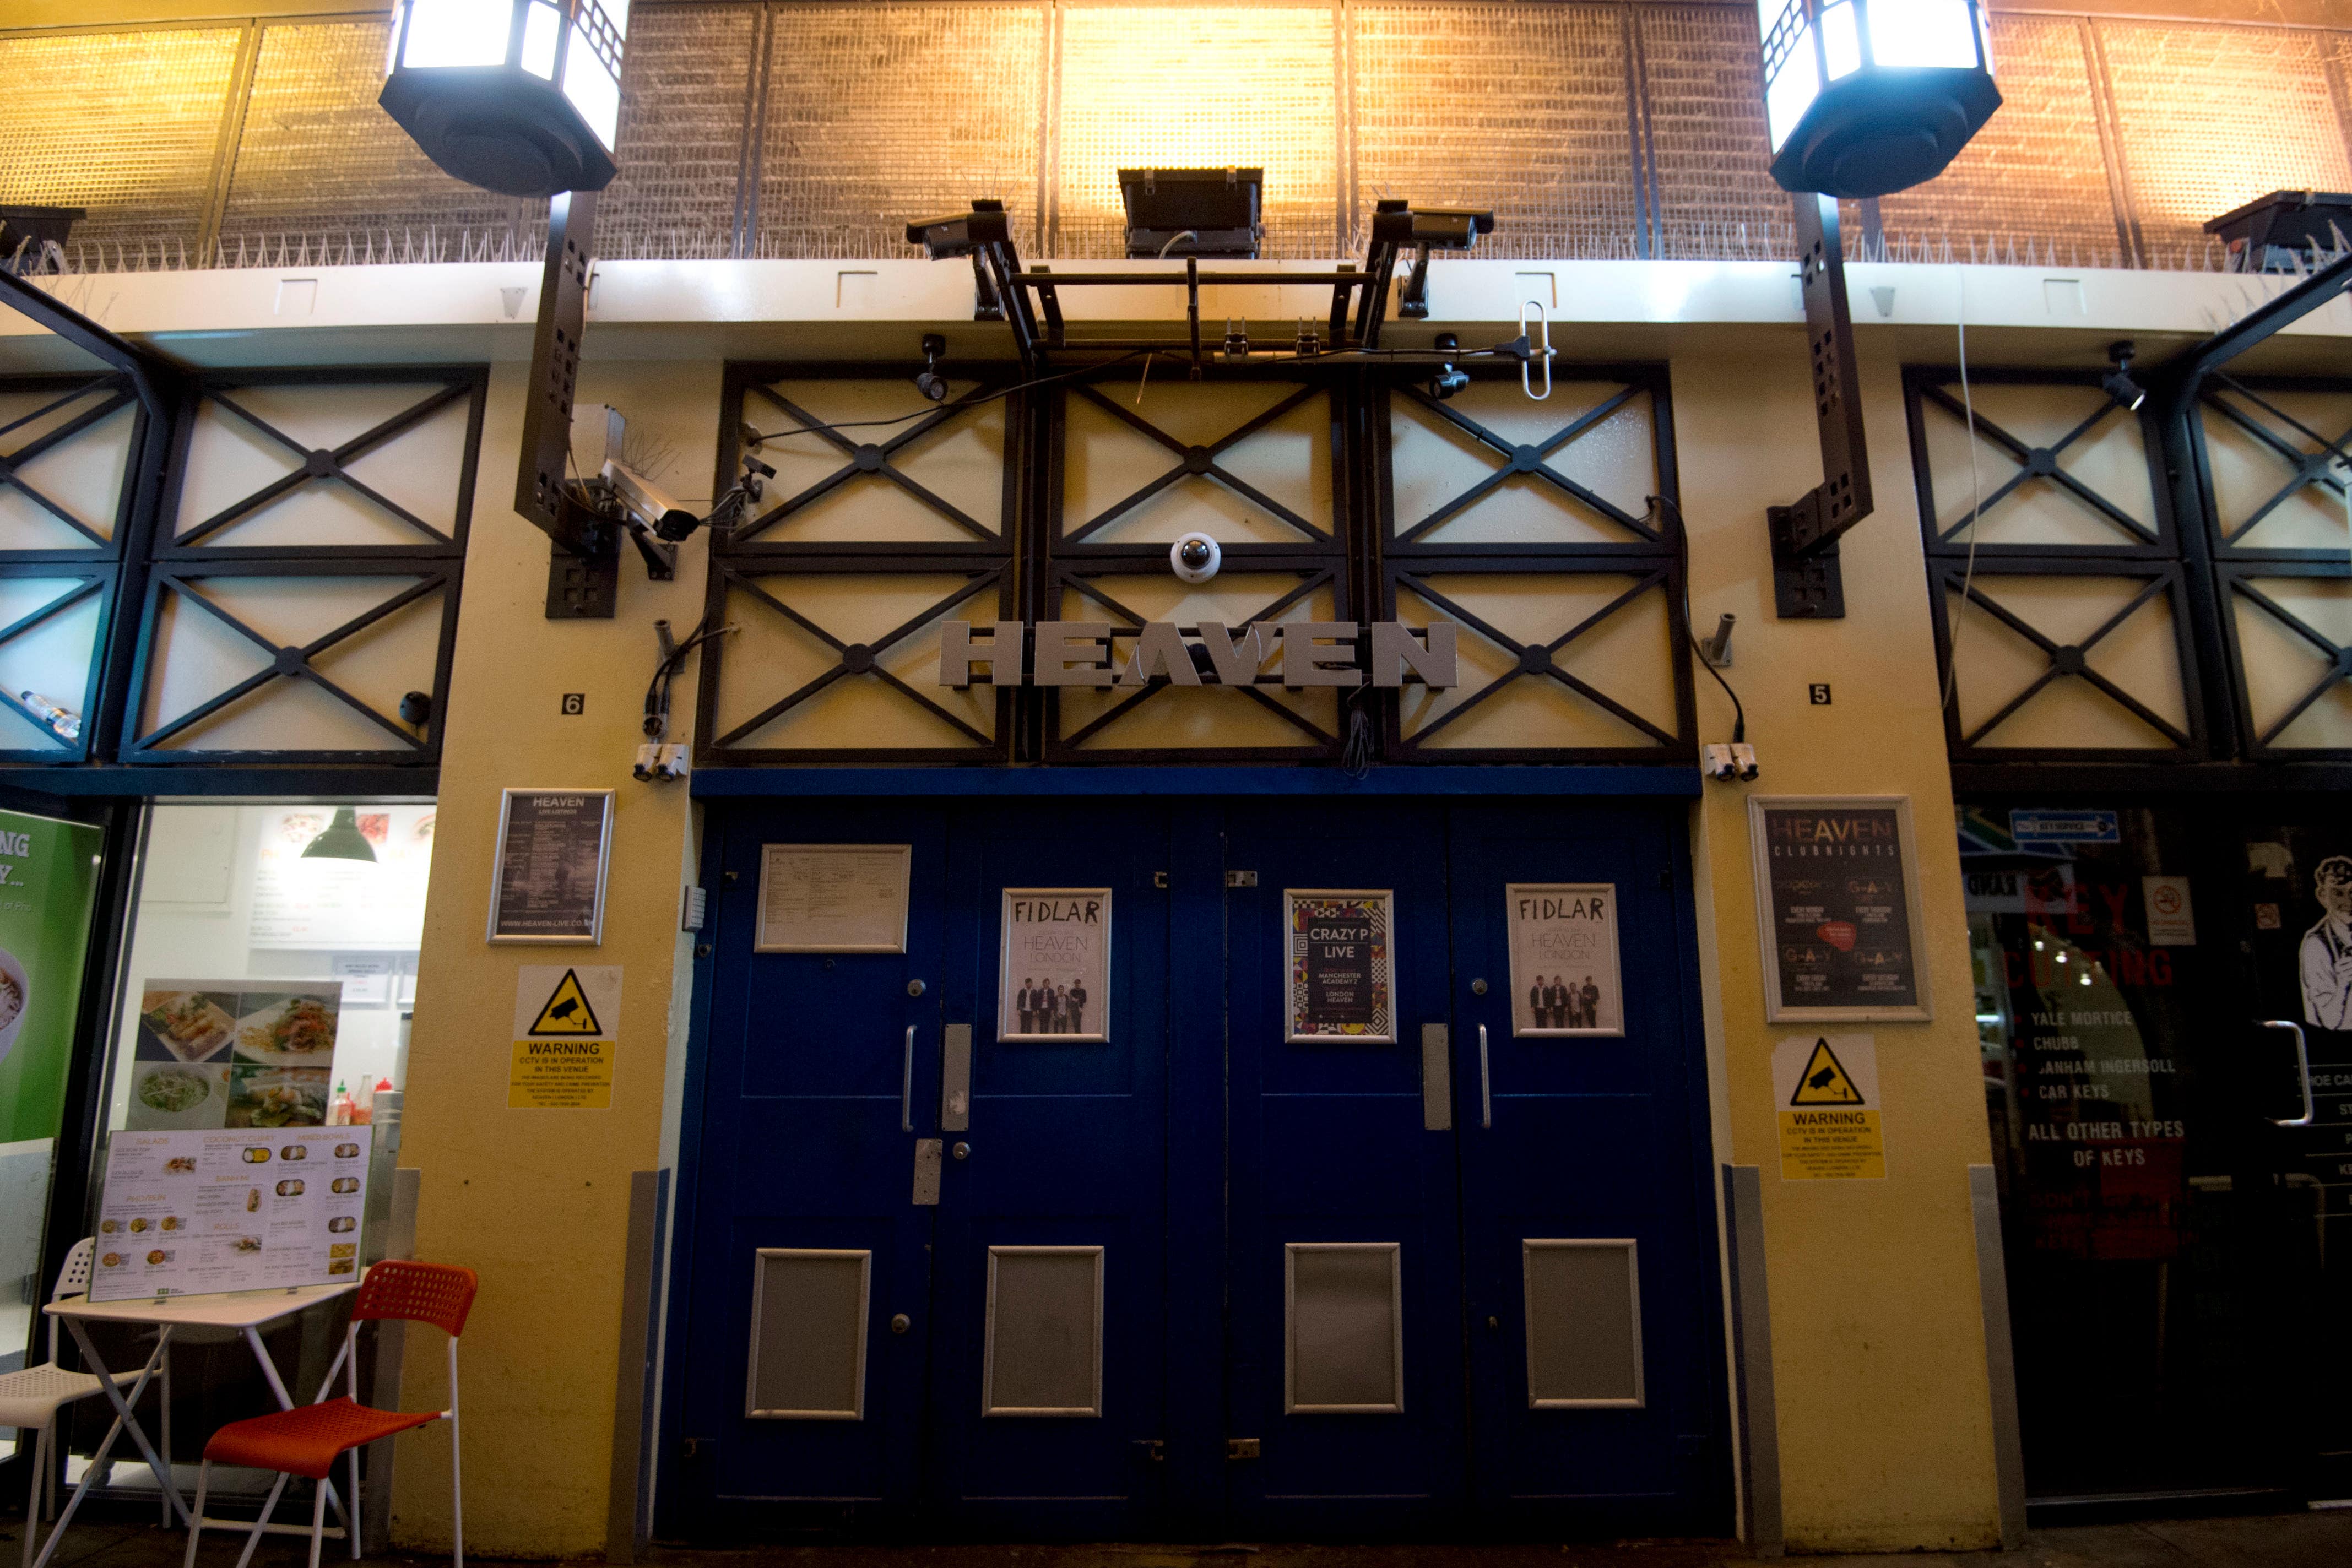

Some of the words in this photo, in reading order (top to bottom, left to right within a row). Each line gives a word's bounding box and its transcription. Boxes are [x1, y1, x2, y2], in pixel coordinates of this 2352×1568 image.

[939, 620, 1459, 687] HEAVEN
[1814, 685, 1828, 703] 5
[566, 695, 581, 713] 6
[533, 797, 584, 807] HEAVEN
[1771, 818, 1893, 843] HEAVEN
[1015, 901, 1100, 924] FIDLAR
[1520, 898, 1604, 920] FIDLAR
[2024, 883, 2128, 935] KEY
[1310, 928, 1356, 940] CRAZY
[1360, 929, 1368, 940] P
[1531, 933, 1596, 947] HEAVEN
[1023, 936, 1088, 950] HEAVEN
[1029, 952, 1081, 963] LONDON
[1325, 946, 1354, 958] LIVE
[1539, 949, 1590, 960] LONDON
[2005, 948, 2174, 990] CUTTING
[2031, 1012, 2065, 1026] YALE
[2071, 1011, 2133, 1025] MORTICE
[529, 1043, 600, 1055] WARNING
[2034, 1036, 2079, 1050] CHUBB
[2039, 1060, 2095, 1074] ANHAM
[2101, 1059, 2176, 1073] INGERSOLL
[2039, 1084, 2067, 1099] CAR
[2072, 1084, 2109, 1099] KEYS
[1793, 1112, 1866, 1125] WARNING
[2028, 1123, 2061, 1141] ALL
[2066, 1122, 2122, 1140] OTHER
[2129, 1120, 2185, 1138] TYPES
[2073, 1149, 2094, 1167] OF
[2101, 1148, 2146, 1166] KEYS
